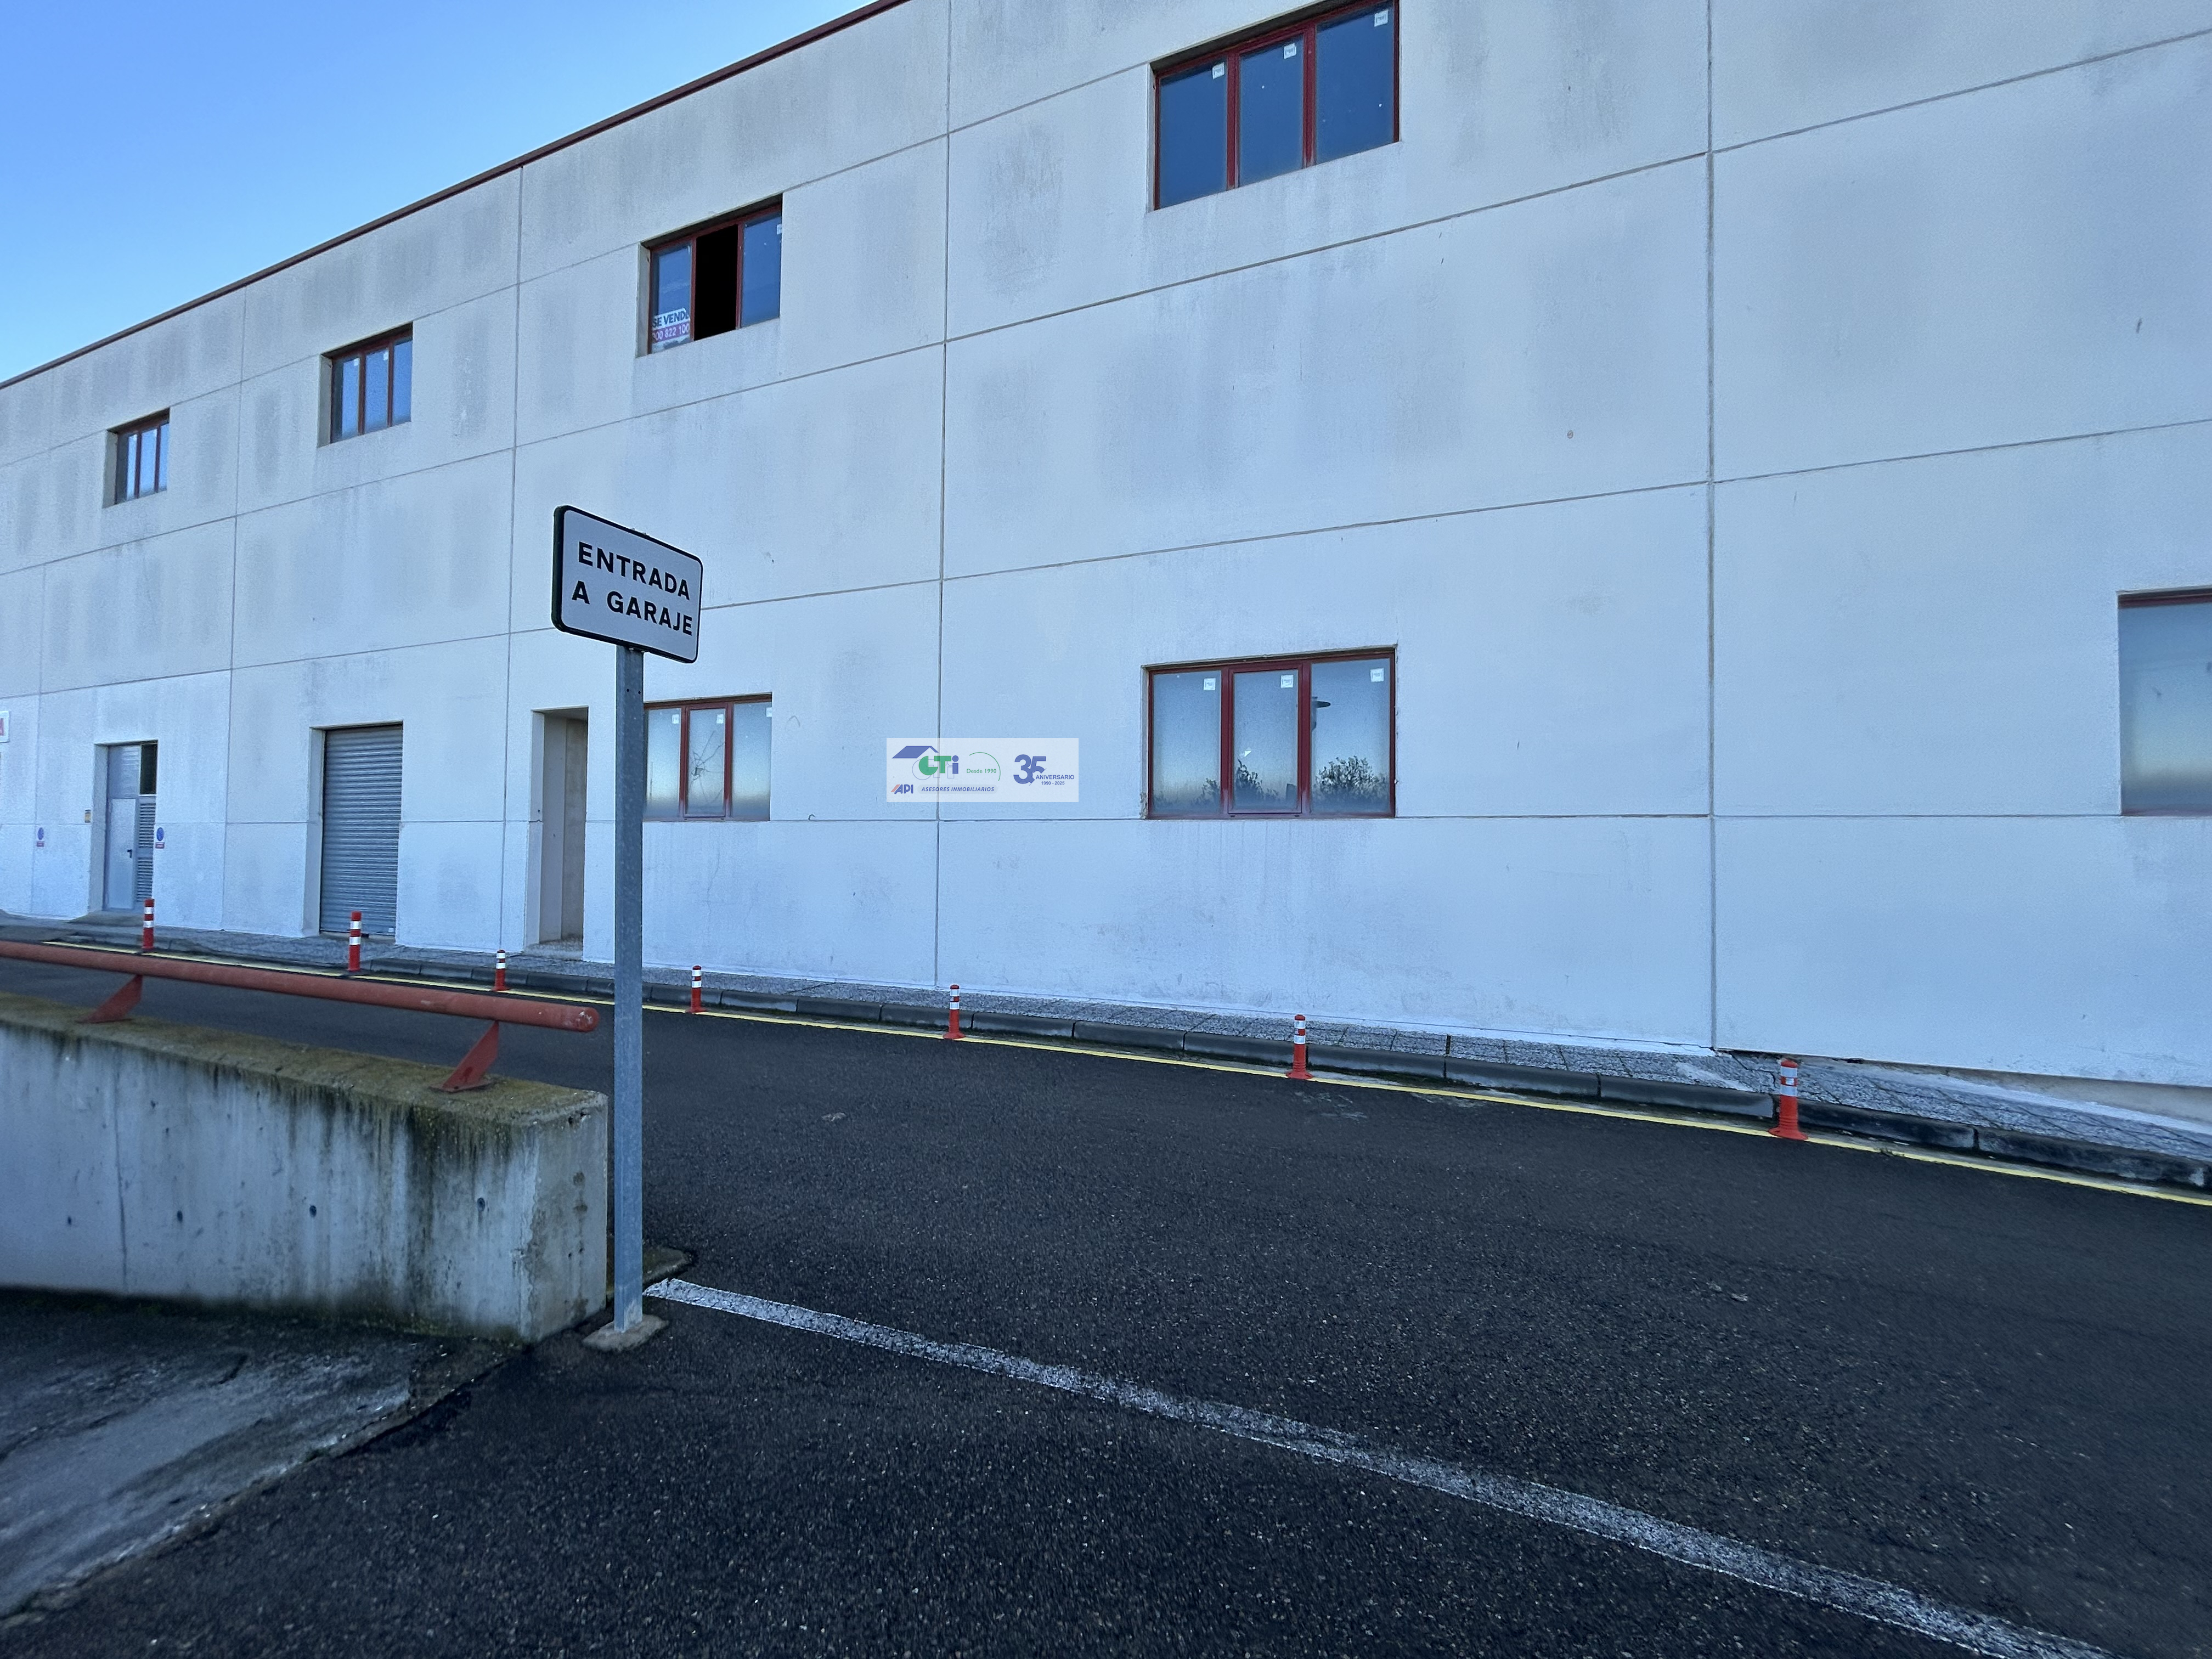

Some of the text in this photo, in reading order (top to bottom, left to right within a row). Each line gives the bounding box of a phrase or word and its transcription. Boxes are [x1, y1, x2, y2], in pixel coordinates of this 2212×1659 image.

[652, 317, 662, 328] SE
[664, 327, 676, 338] 822
[578, 541, 690, 600] ENTRADA
[572, 580, 692, 636] A GARAJE
